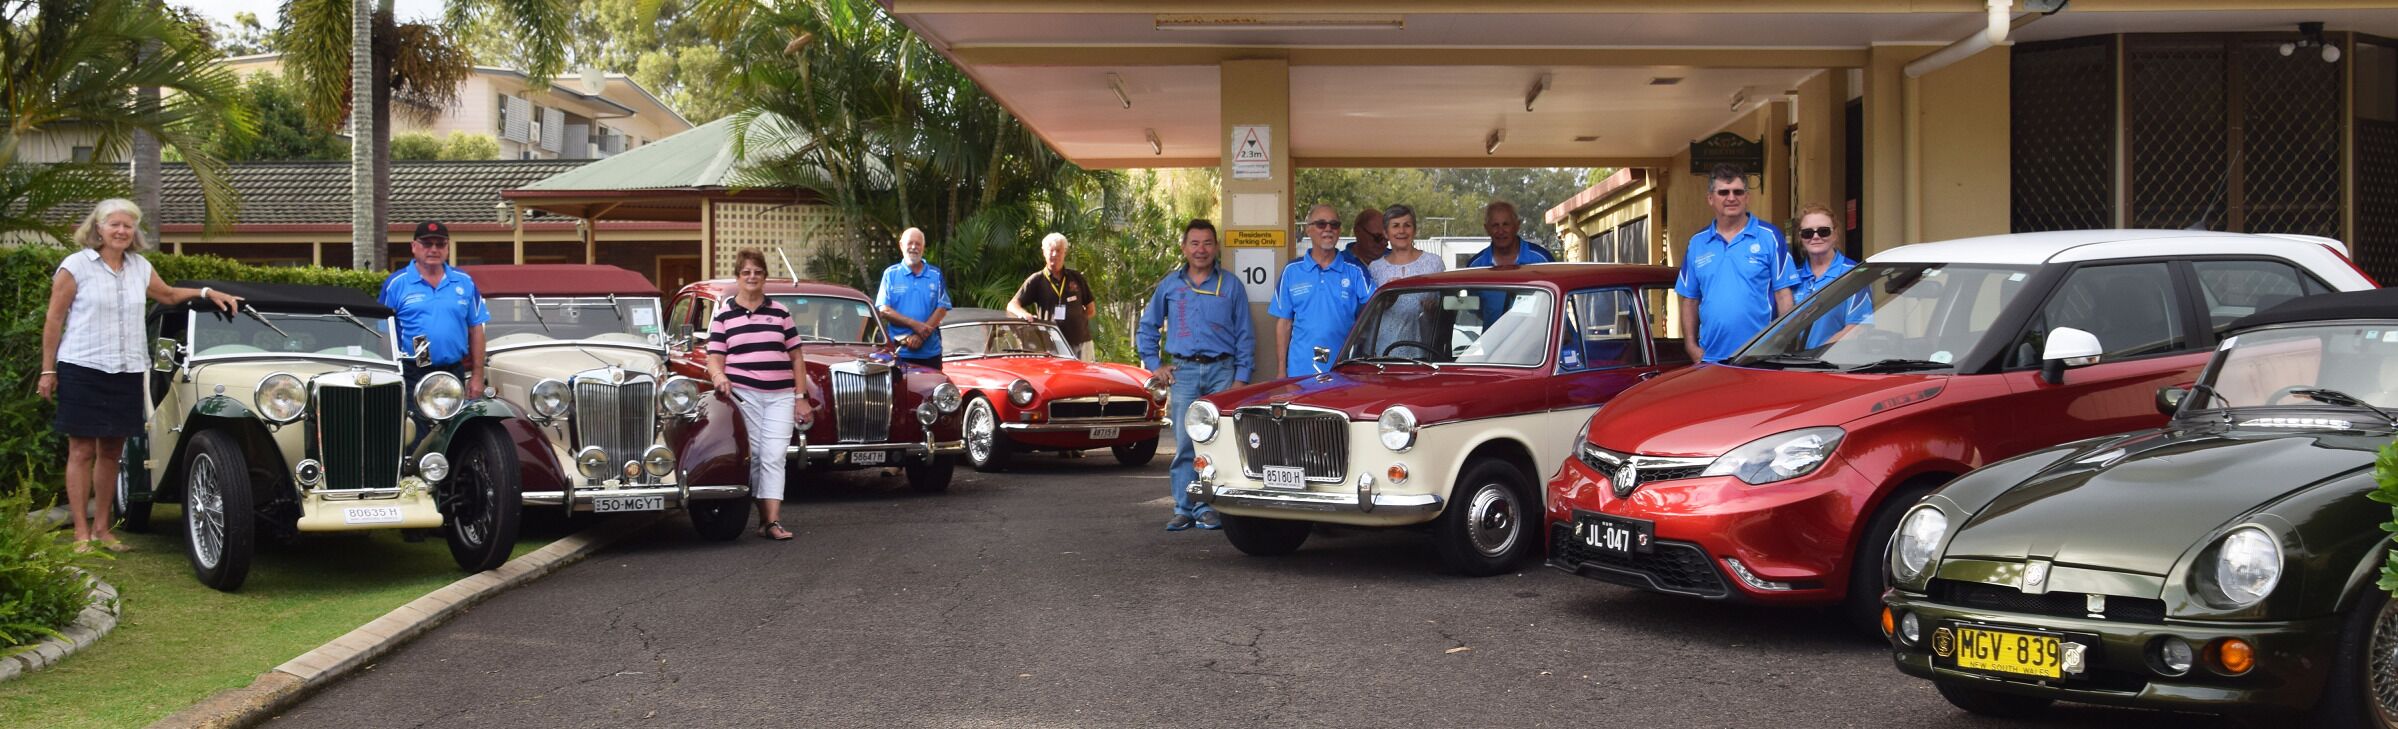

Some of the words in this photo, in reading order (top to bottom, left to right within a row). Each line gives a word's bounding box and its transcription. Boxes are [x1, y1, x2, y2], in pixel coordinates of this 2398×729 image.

[1241, 150, 1262, 158] 2.3m
[1242, 266, 1267, 285] 10
[1267, 470, 1292, 483] 85180
[349, 509, 386, 518] 80635
[1970, 661, 1986, 669] NEW
[1991, 663, 2018, 672] SOUTH
[2023, 666, 2050, 676] WALES
